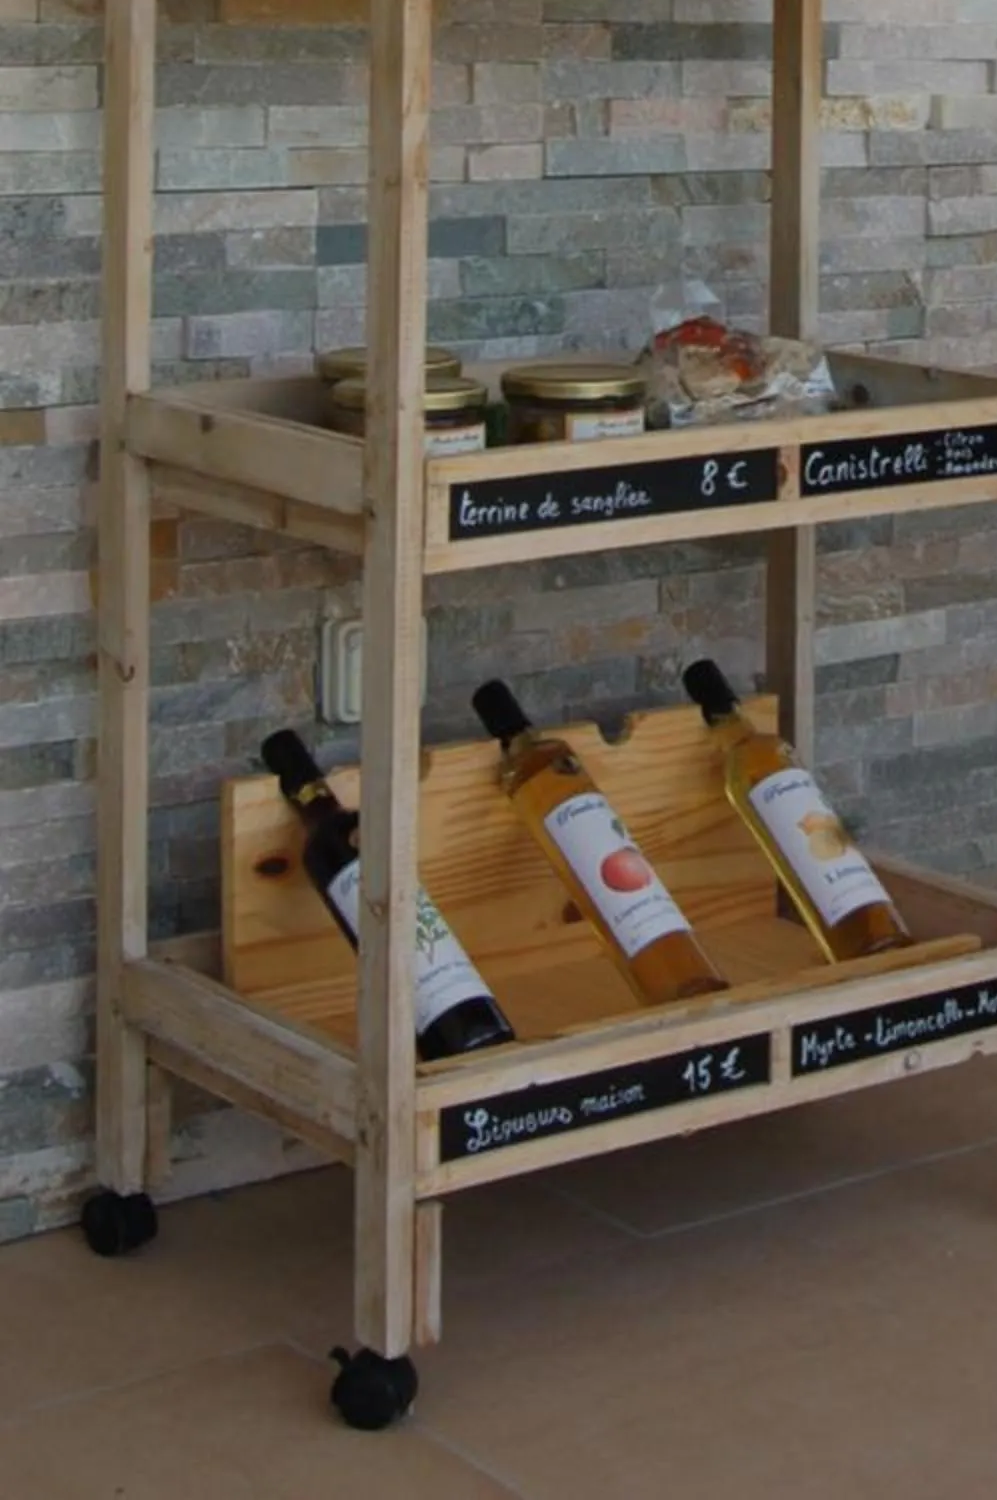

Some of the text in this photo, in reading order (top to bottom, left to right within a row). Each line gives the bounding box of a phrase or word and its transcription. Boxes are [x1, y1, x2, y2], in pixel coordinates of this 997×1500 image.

[458, 490, 529, 526] terrine
[537, 492, 560, 518] de
[580, 1083, 645, 1116] maison
